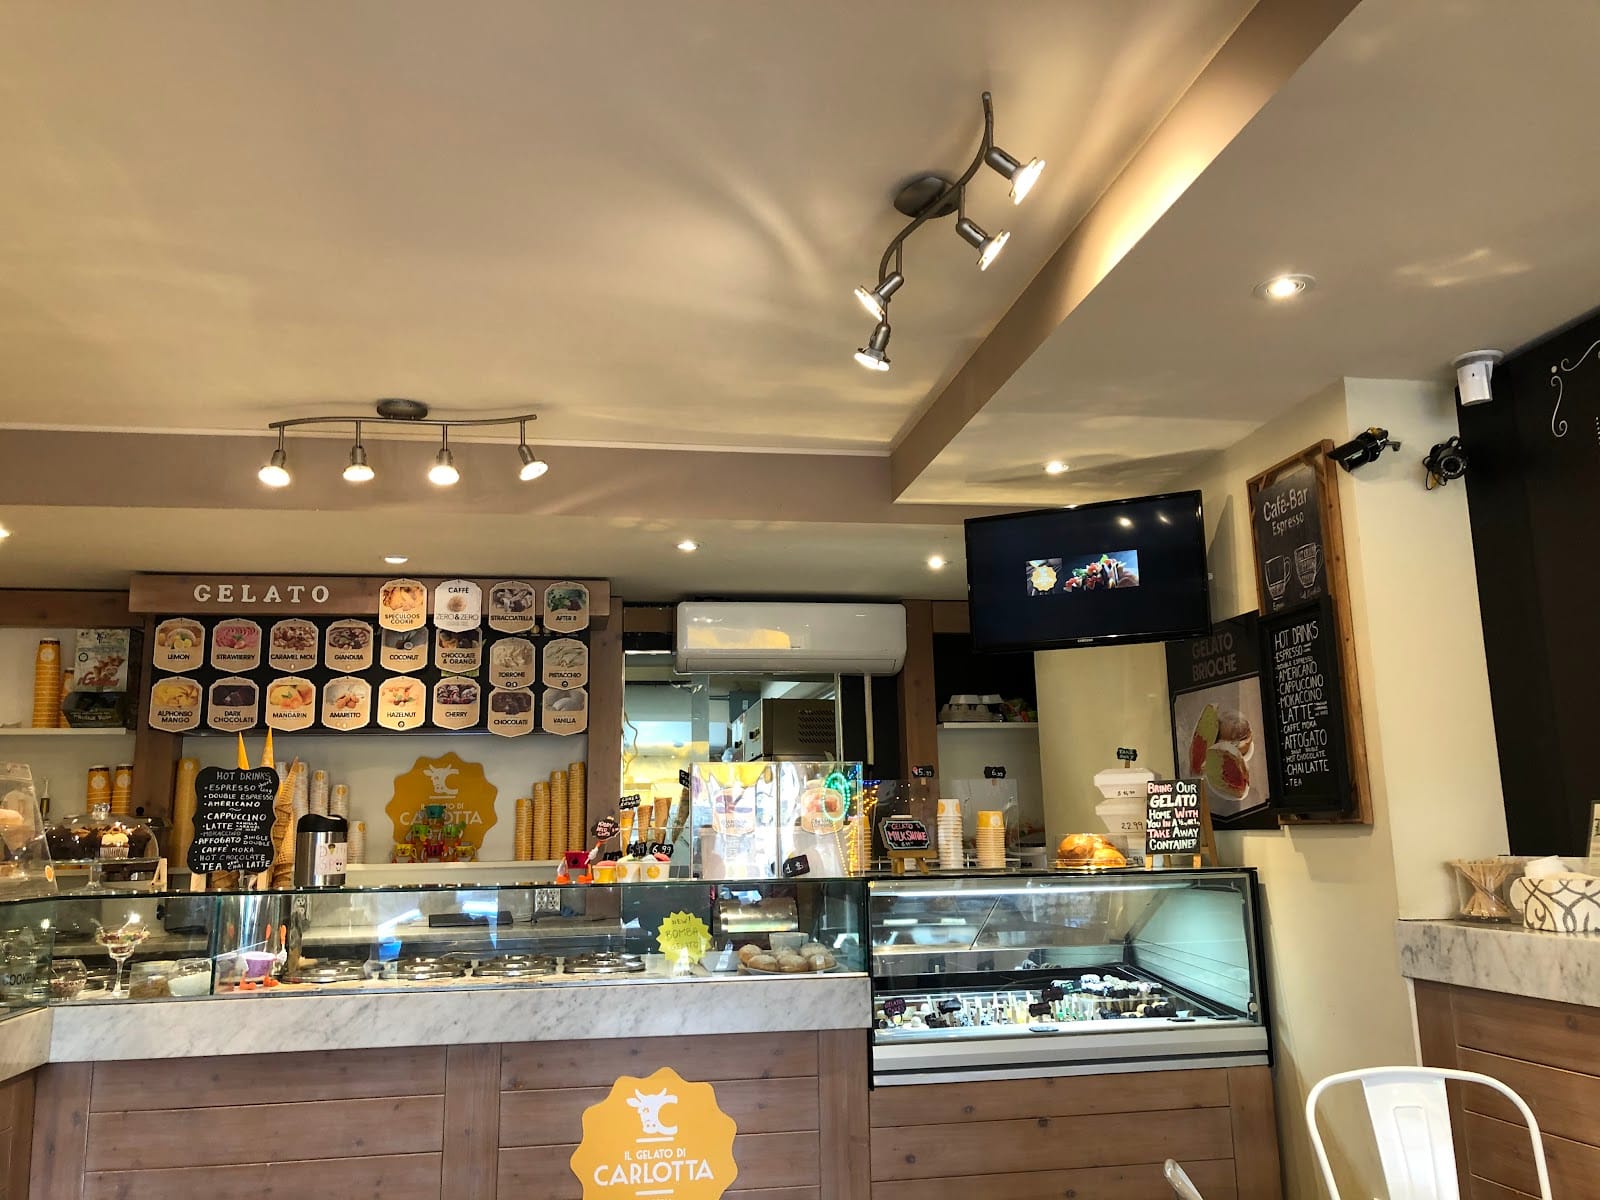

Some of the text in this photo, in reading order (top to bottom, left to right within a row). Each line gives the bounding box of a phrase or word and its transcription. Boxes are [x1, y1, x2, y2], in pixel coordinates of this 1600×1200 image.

[1263, 487, 1308, 522] Café-Bar
[1272, 511, 1305, 536] Espresso
[193, 584, 330, 603] GELATO
[1191, 632, 1233, 659] GELATO
[1274, 630, 1289, 651] HOT
[1276, 645, 1303, 663] ESPRESSO
[1192, 653, 1237, 681] BRIOCHE
[1280, 674, 1324, 695] CAPPUCCINO
[1281, 703, 1315, 724] LATTE
[1305, 759, 1330, 774] LATTE
[216, 771, 271, 781] HOT DRINKS
[1289, 778, 1303, 787] TEA
[209, 784, 256, 792] ESPRESSO
[1147, 781, 1197, 794] BRING OUR
[1150, 794, 1197, 808] GELATO
[207, 812, 267, 822] CAPPUCCINO
[1149, 807, 1199, 820] HOME WITH
[205, 823, 234, 831] LATTE
[1147, 819, 1161, 828] YOU
[1162, 819, 1171, 827] IN
[1147, 827, 1199, 839] TAKE AWAY
[198, 837, 242, 845] AFFOGATO
[1149, 838, 1197, 851] CONTAINER
[200, 862, 223, 871] TEA
[246, 860, 271, 869] LATTE
[624, 1147, 686, 1161] IL GELATO DI
[593, 1159, 715, 1186] CARLOTTA
